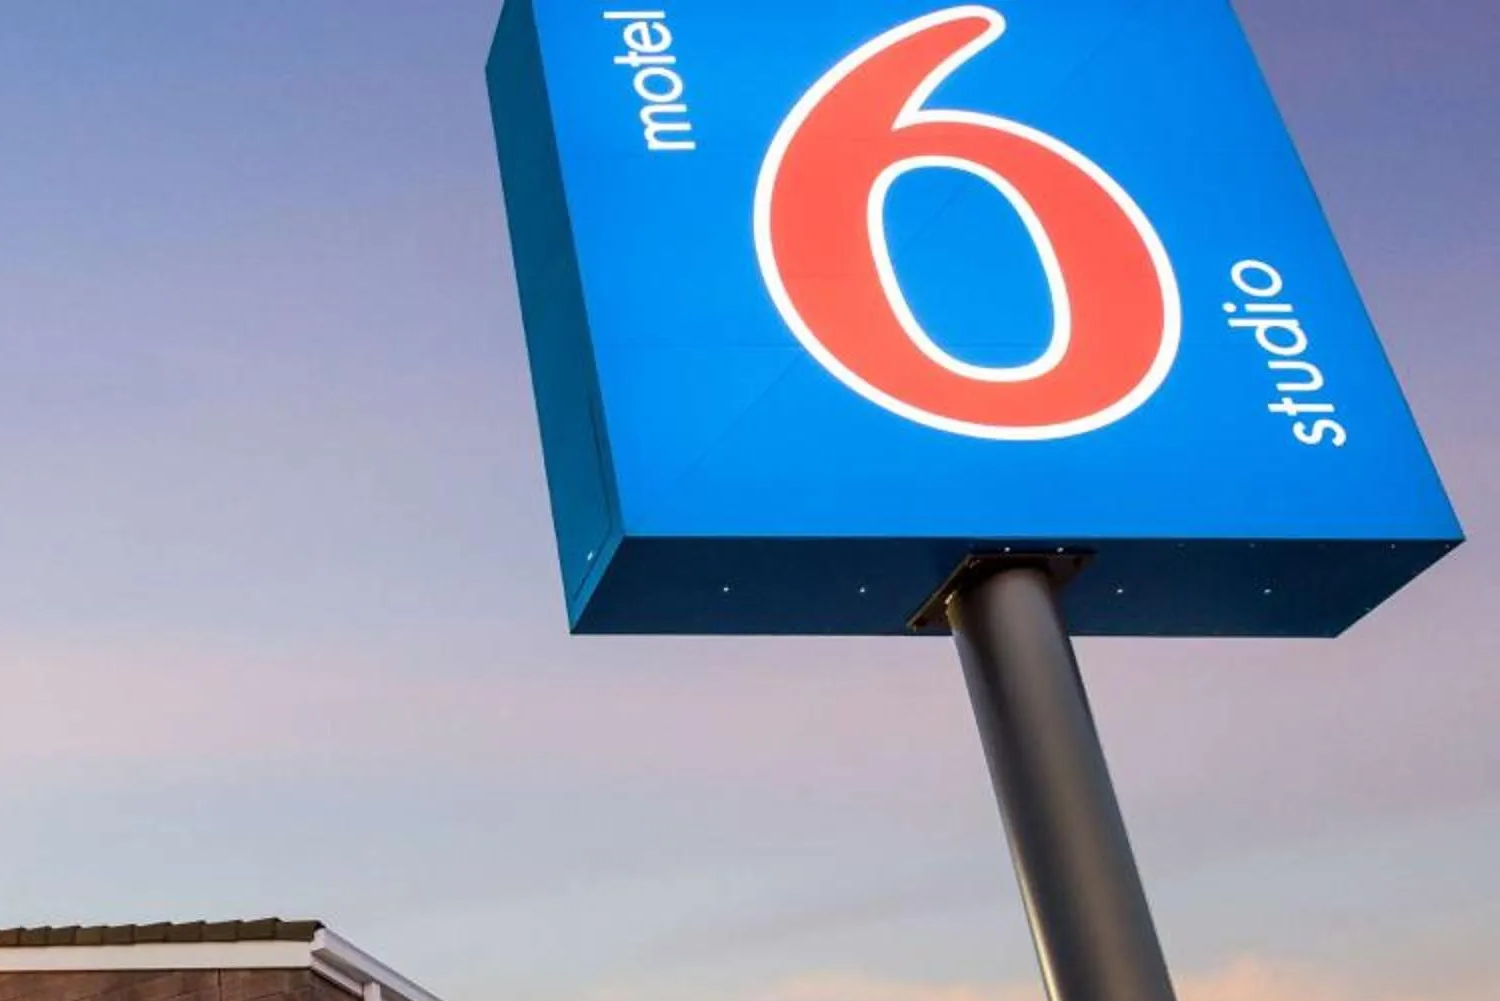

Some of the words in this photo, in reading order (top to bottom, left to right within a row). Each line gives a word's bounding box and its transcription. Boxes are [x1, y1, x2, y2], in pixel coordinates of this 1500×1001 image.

[603, 10, 696, 151] motel
[752, 4, 1183, 441] 6
[1223, 259, 1347, 447] studio
